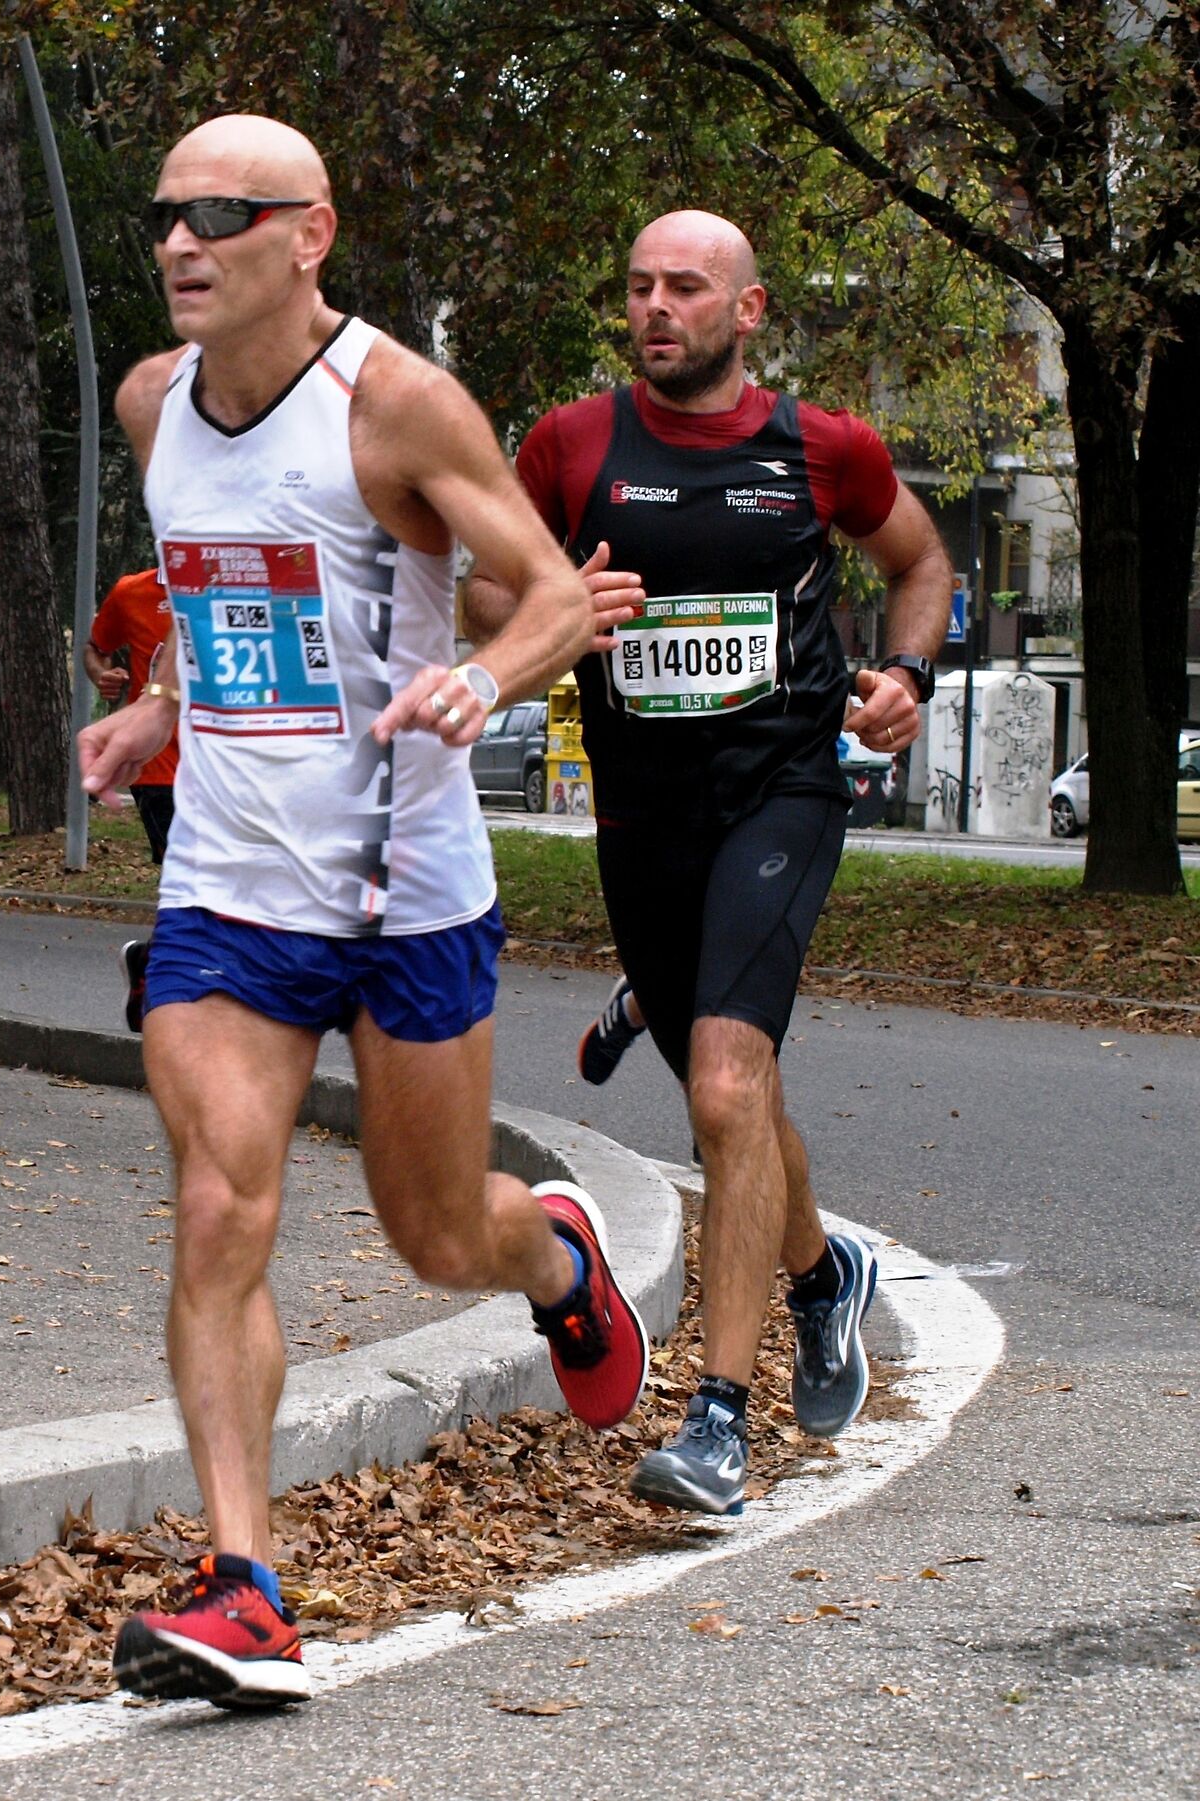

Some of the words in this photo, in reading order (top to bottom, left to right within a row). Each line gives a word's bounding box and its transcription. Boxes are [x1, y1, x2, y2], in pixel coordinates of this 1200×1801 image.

[621, 486, 678, 496] OFFICINA
[725, 488, 754, 497] Studio
[755, 488, 796, 500] Dentistico
[725, 496, 758, 507] Tiozzi
[738, 507, 782, 516] CESENATICO
[646, 603, 673, 617] GOOD
[675, 601, 721, 615] MORNING
[724, 599, 769, 613] RAVENNA
[212, 638, 279, 685] 321
[648, 637, 743, 677] 14088
[222, 689, 256, 704] LUCA
[679, 694, 702, 710] 10,5
[704, 693, 713, 709] K
